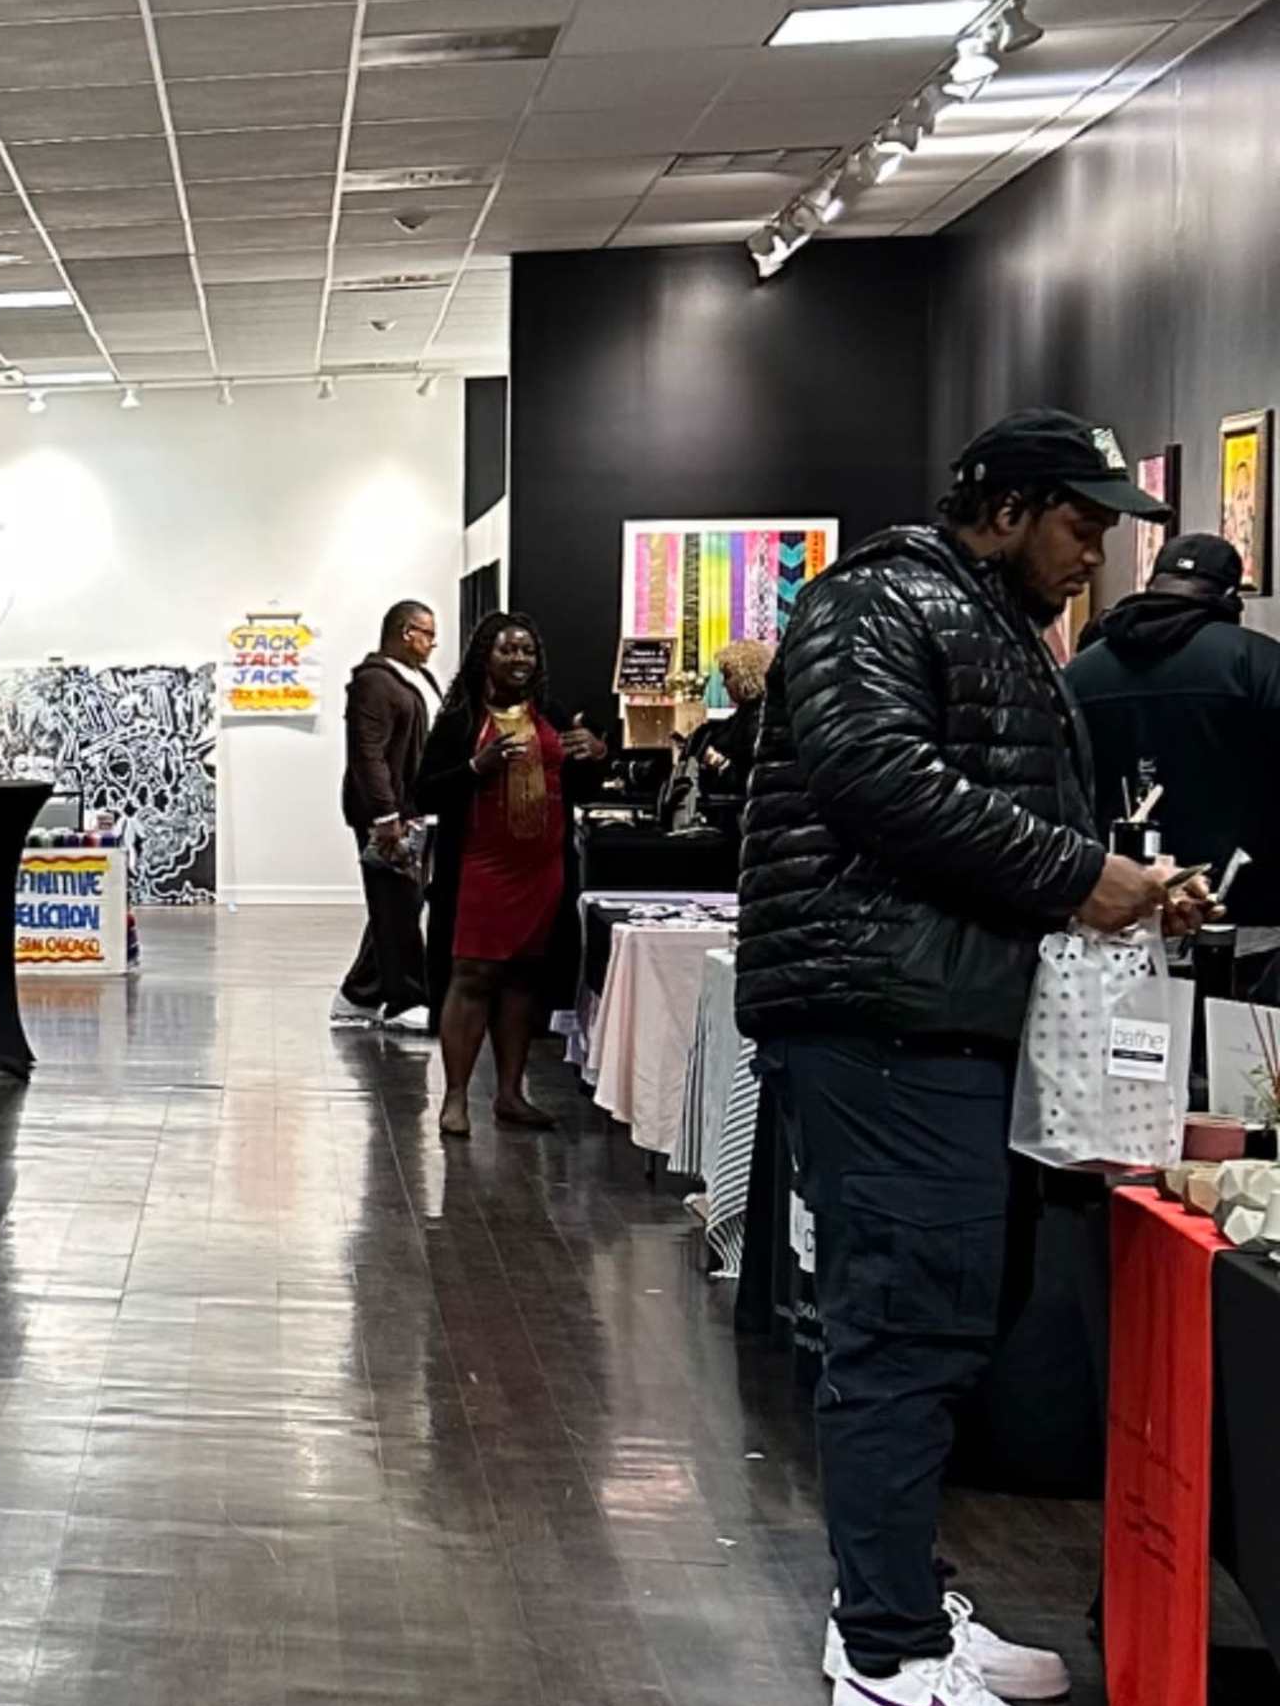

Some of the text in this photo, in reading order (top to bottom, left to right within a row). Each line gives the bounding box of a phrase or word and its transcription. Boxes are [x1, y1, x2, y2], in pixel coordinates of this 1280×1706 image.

[233, 634, 300, 650] JACK
[233, 652, 300, 667] JACK
[233, 669, 300, 685] JACK
[16, 871, 104, 896] FINITIVE
[1113, 1027, 1165, 1050] bathe
